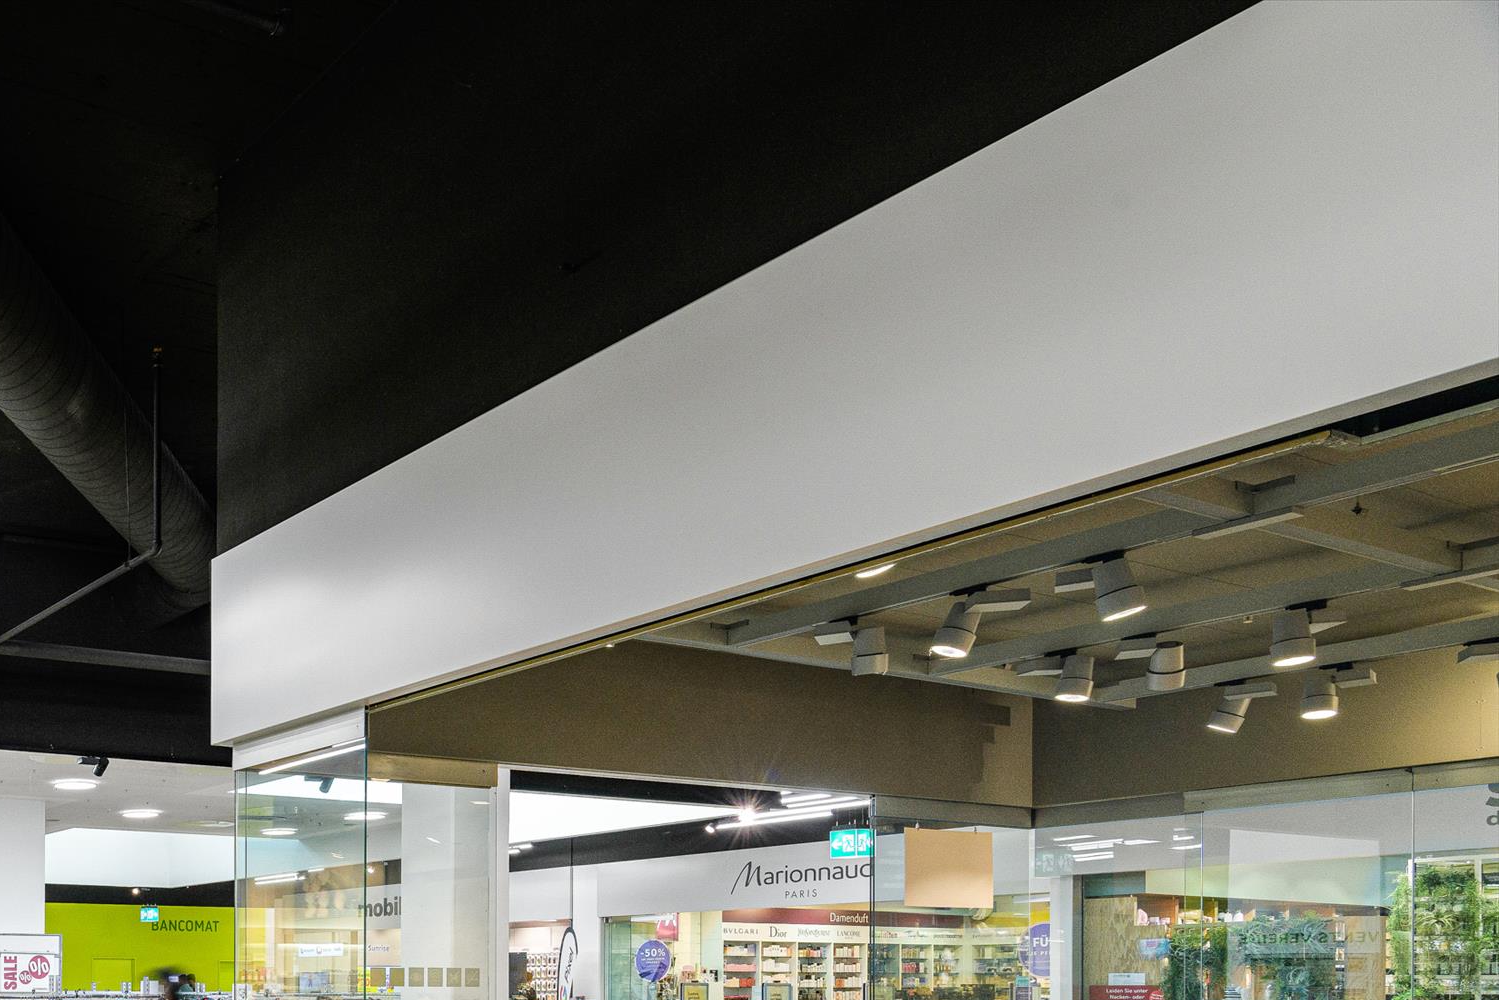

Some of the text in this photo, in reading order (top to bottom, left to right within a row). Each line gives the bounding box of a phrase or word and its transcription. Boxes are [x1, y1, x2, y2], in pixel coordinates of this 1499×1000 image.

[784, 889, 818, 899] PARIS
[151, 919, 220, 932] BANCOMAT
[769, 926, 787, 938] Dior
[367, 944, 390, 952] Sunrise
[640, 948, 666, 958] -50%
[3, 955, 18, 991] SALE
